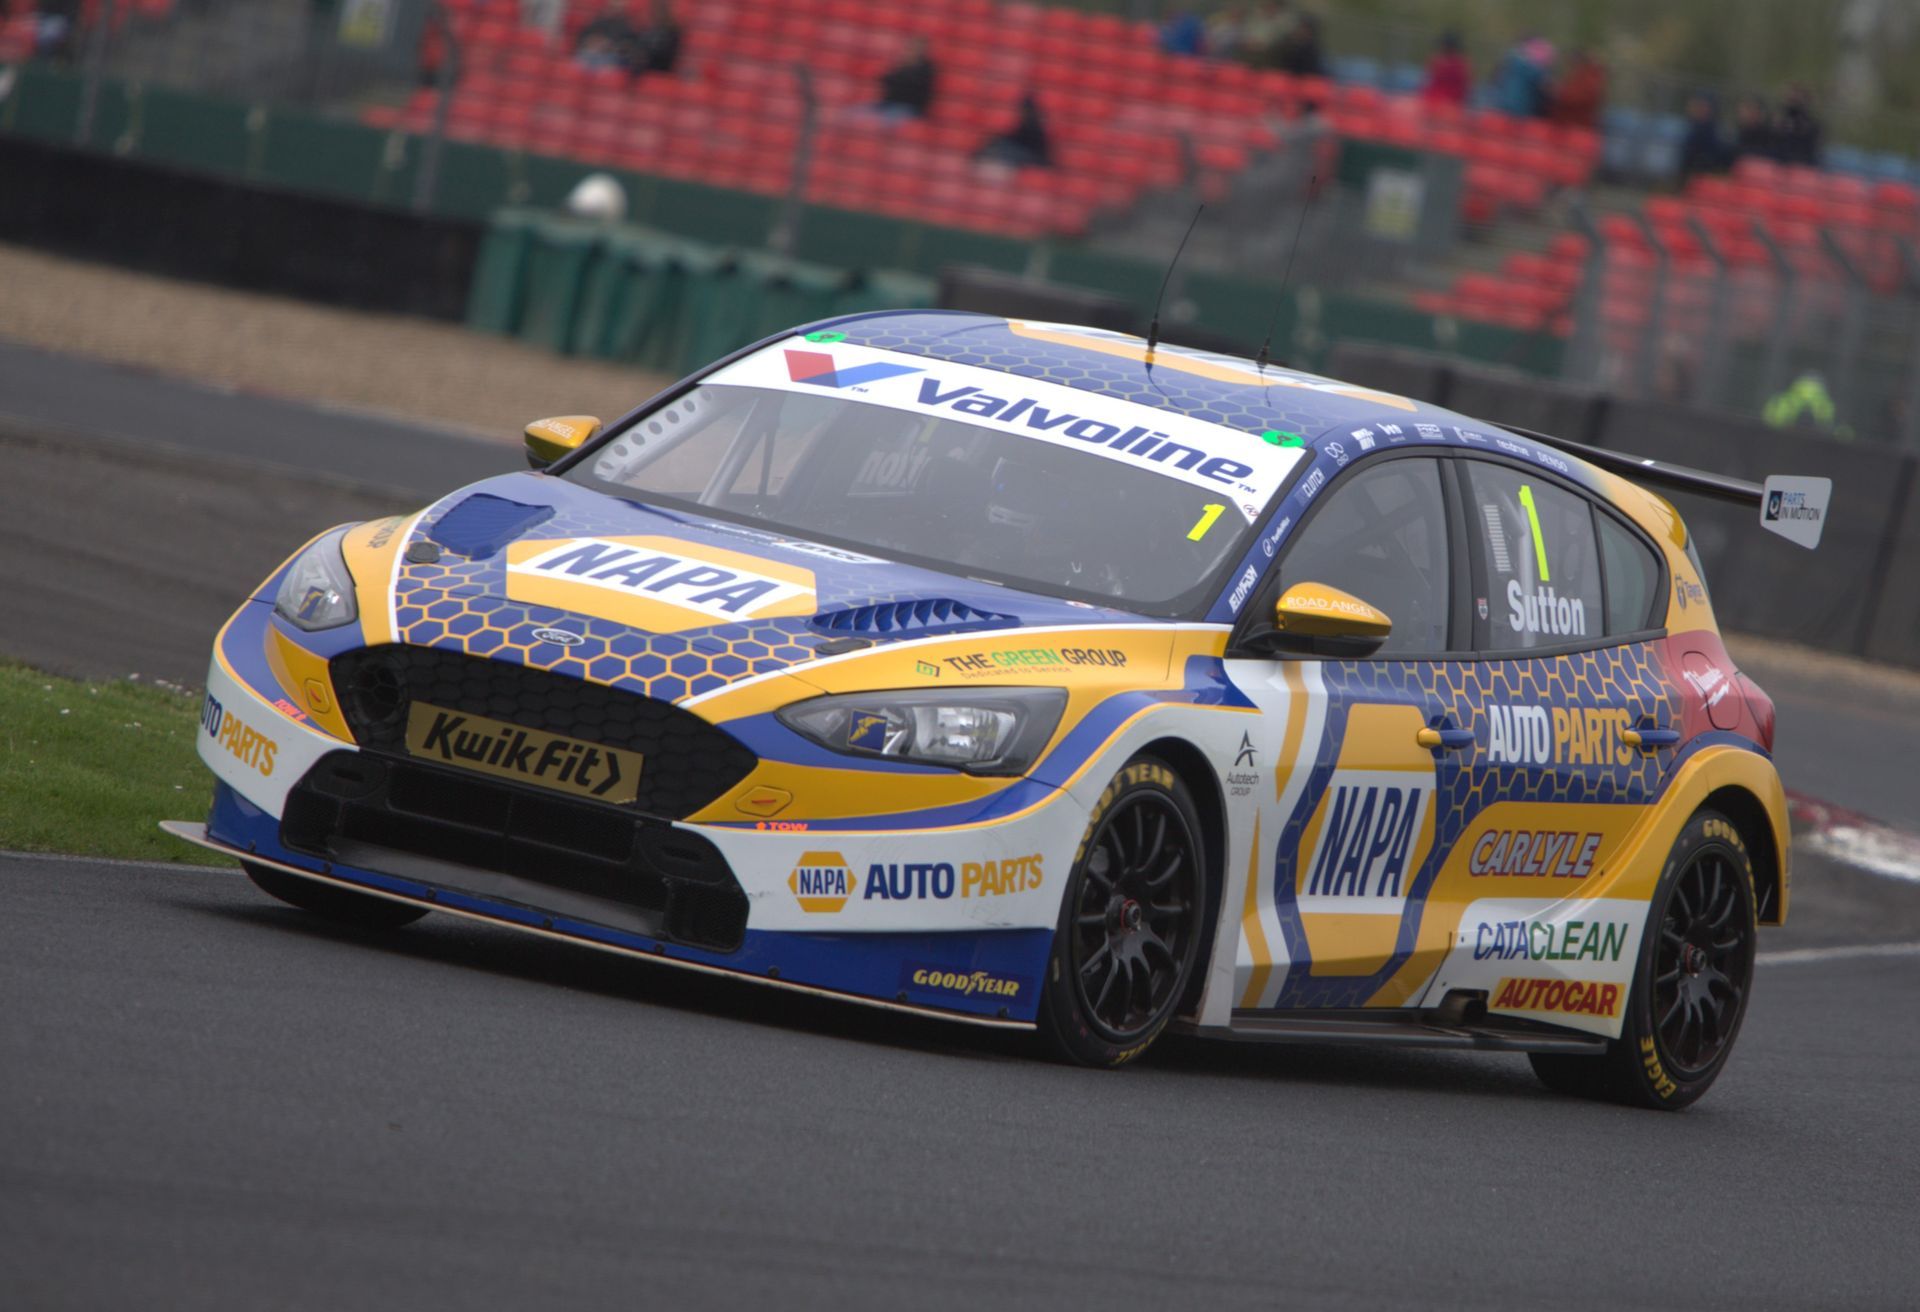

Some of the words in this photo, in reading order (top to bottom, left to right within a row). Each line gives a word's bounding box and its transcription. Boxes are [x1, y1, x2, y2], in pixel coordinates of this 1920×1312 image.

[917, 377, 1254, 486] Valvoline
[1188, 504, 1223, 540] 1
[1519, 485, 1550, 581] 1
[535, 542, 783, 615] NAPA
[1287, 597, 1329, 609] ROAD
[1331, 601, 1376, 619] ANGEL
[1507, 589, 1586, 635] Sutton
[943, 653, 995, 671] THE
[991, 648, 1064, 667] GREEN
[1061, 648, 1127, 668] GROUP
[219, 711, 278, 777] PARTS
[1487, 704, 1549, 764] AUTO
[1554, 707, 1634, 765] PARTS
[1308, 786, 1422, 898] NAPA
[1469, 830, 1603, 879] CARLYLE
[800, 869, 846, 896] NAPA
[864, 862, 956, 900] AUTO
[961, 853, 1044, 897] PARTS
[1473, 921, 1629, 961] CATACLEAN
[913, 969, 1019, 997] GOODYEAR
[1495, 978, 1619, 1016] AUTOCAR
